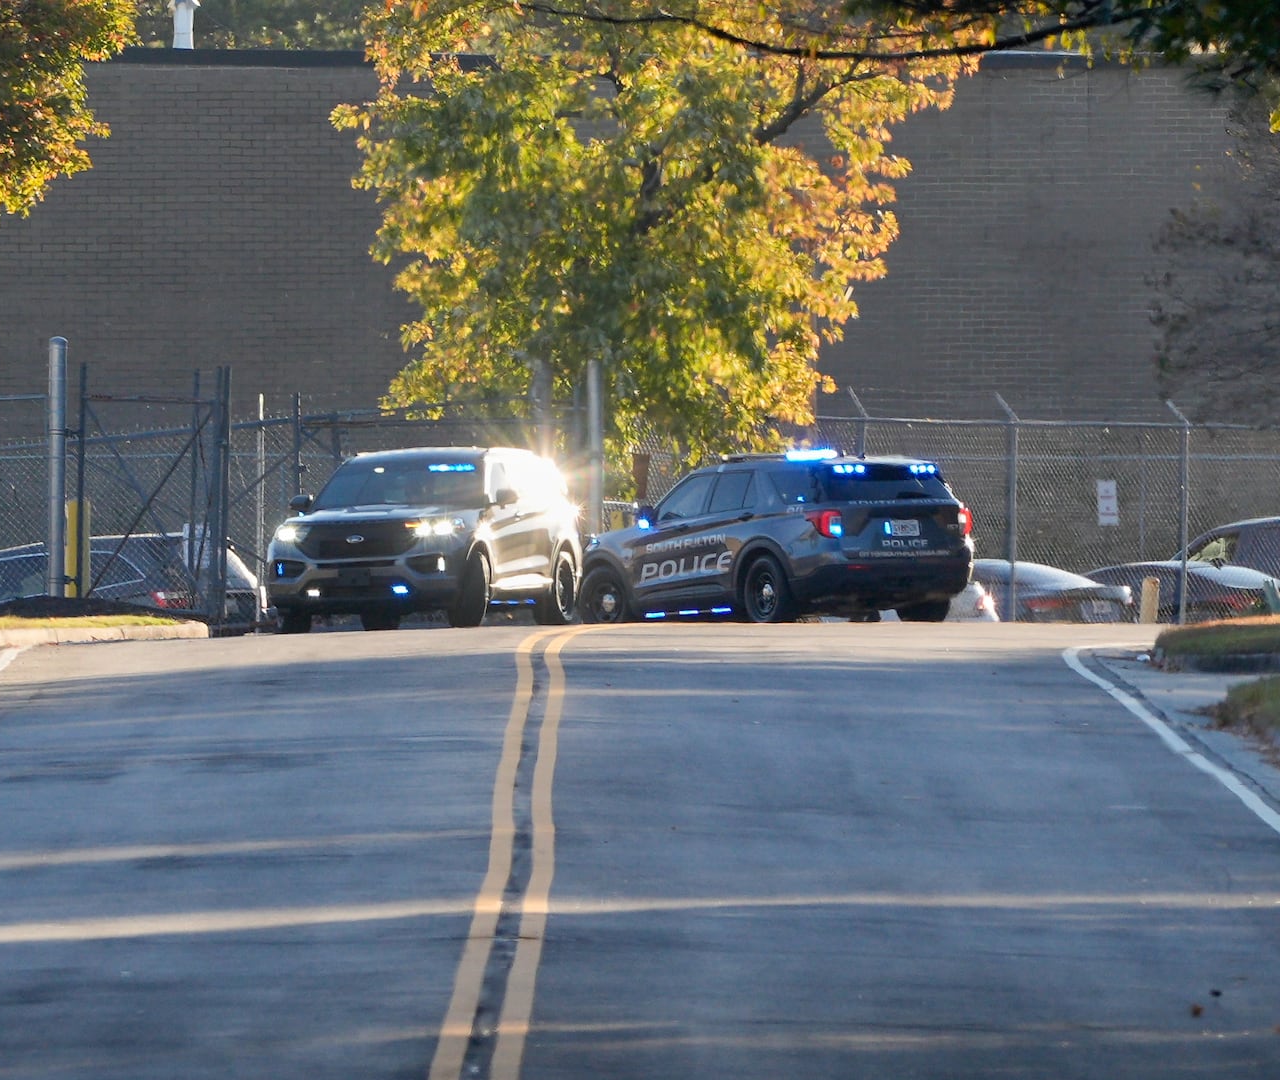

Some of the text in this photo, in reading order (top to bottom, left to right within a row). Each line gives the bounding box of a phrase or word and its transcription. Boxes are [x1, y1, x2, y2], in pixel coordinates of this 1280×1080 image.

[645, 533, 726, 554] SOUTH FULTON
[881, 539, 929, 548] POLICE
[639, 550, 734, 584] POLICE
